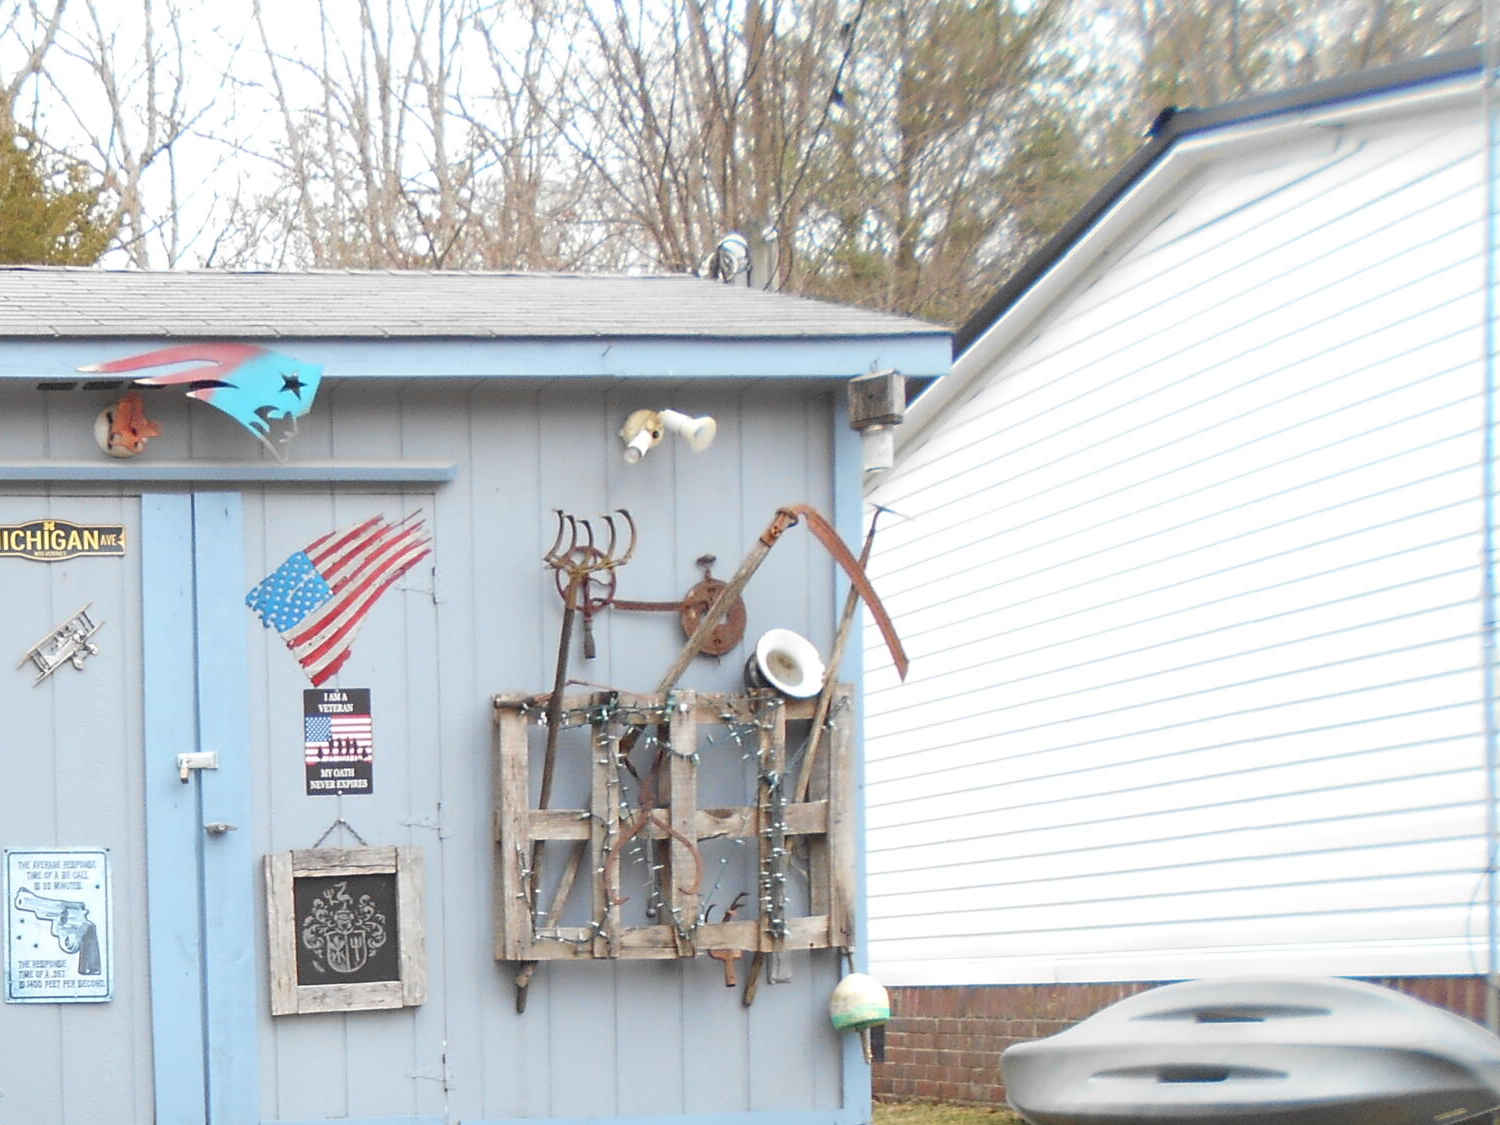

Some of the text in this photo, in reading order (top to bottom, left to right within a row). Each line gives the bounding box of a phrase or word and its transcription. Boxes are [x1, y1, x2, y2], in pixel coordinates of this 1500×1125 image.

[100, 534, 117, 546] AVE
[318, 704, 354, 713] VETERAN
[320, 768, 355, 778] MY OATH
[310, 779, 368, 789] NEVER EXPIRES
